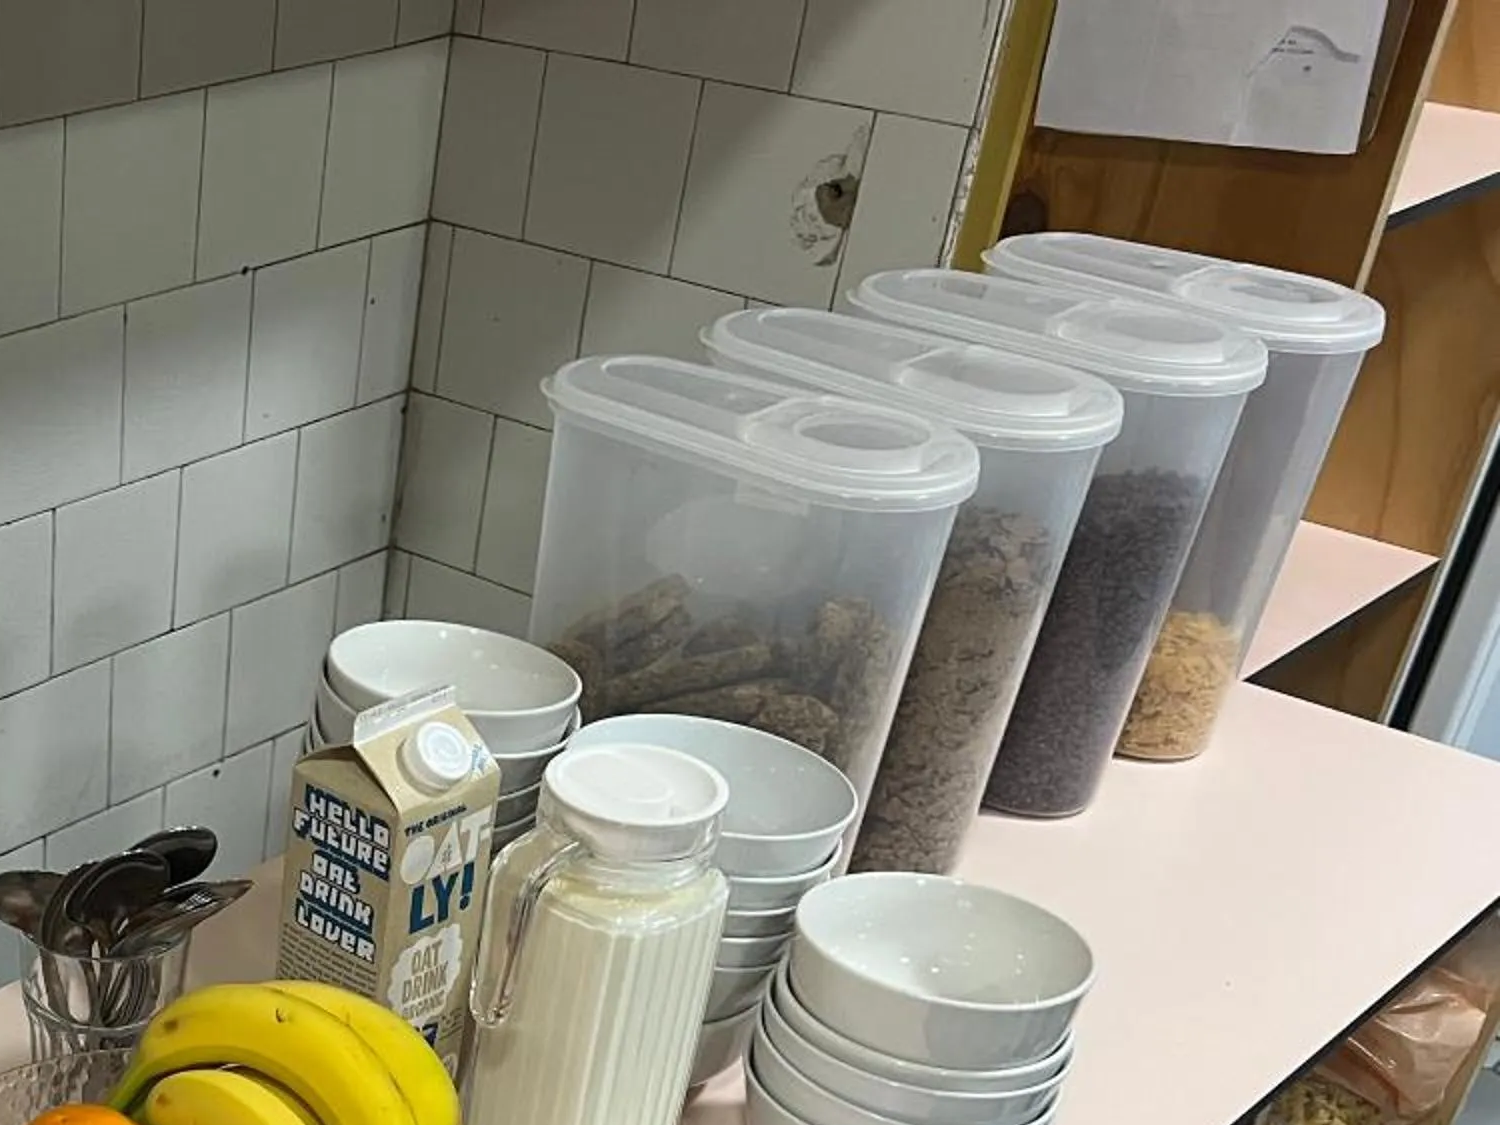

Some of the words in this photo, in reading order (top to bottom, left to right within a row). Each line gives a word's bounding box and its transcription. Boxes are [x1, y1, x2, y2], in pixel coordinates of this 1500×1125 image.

[309, 793, 388, 848] HELLO
[405, 821, 424, 837] THE
[426, 804, 467, 832] ORIGINAL
[409, 862, 474, 934] LY!
[411, 940, 442, 977] OAT
[403, 960, 449, 1003] DRINK
